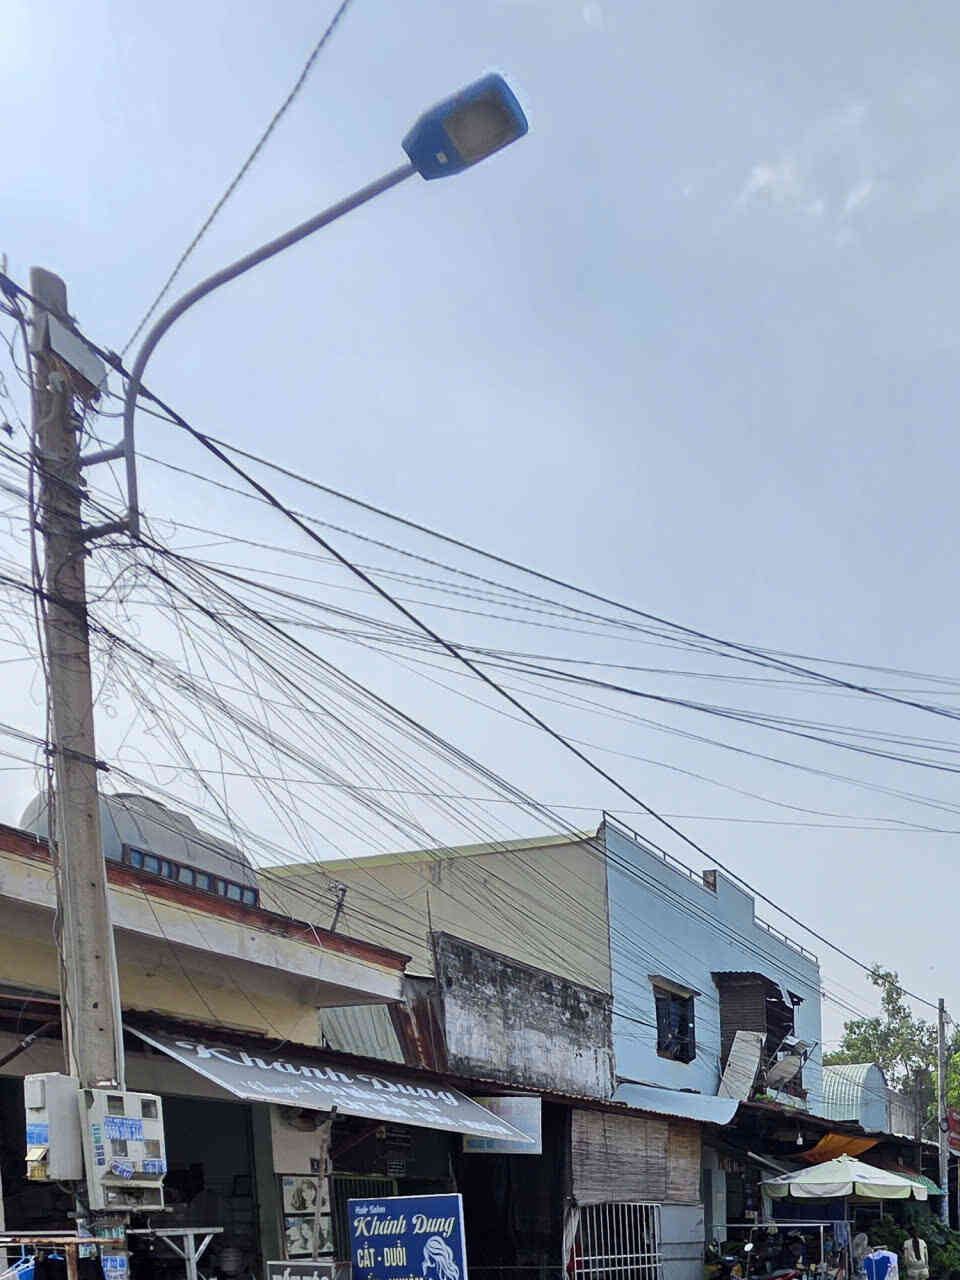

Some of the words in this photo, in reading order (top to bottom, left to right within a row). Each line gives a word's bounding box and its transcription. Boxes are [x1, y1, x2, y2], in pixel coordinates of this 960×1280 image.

[176, 1041, 354, 1084] Khánh
[356, 1073, 459, 1107] Dung
[354, 1215, 406, 1237] Khánh
[412, 1214, 455, 1238] Dung
